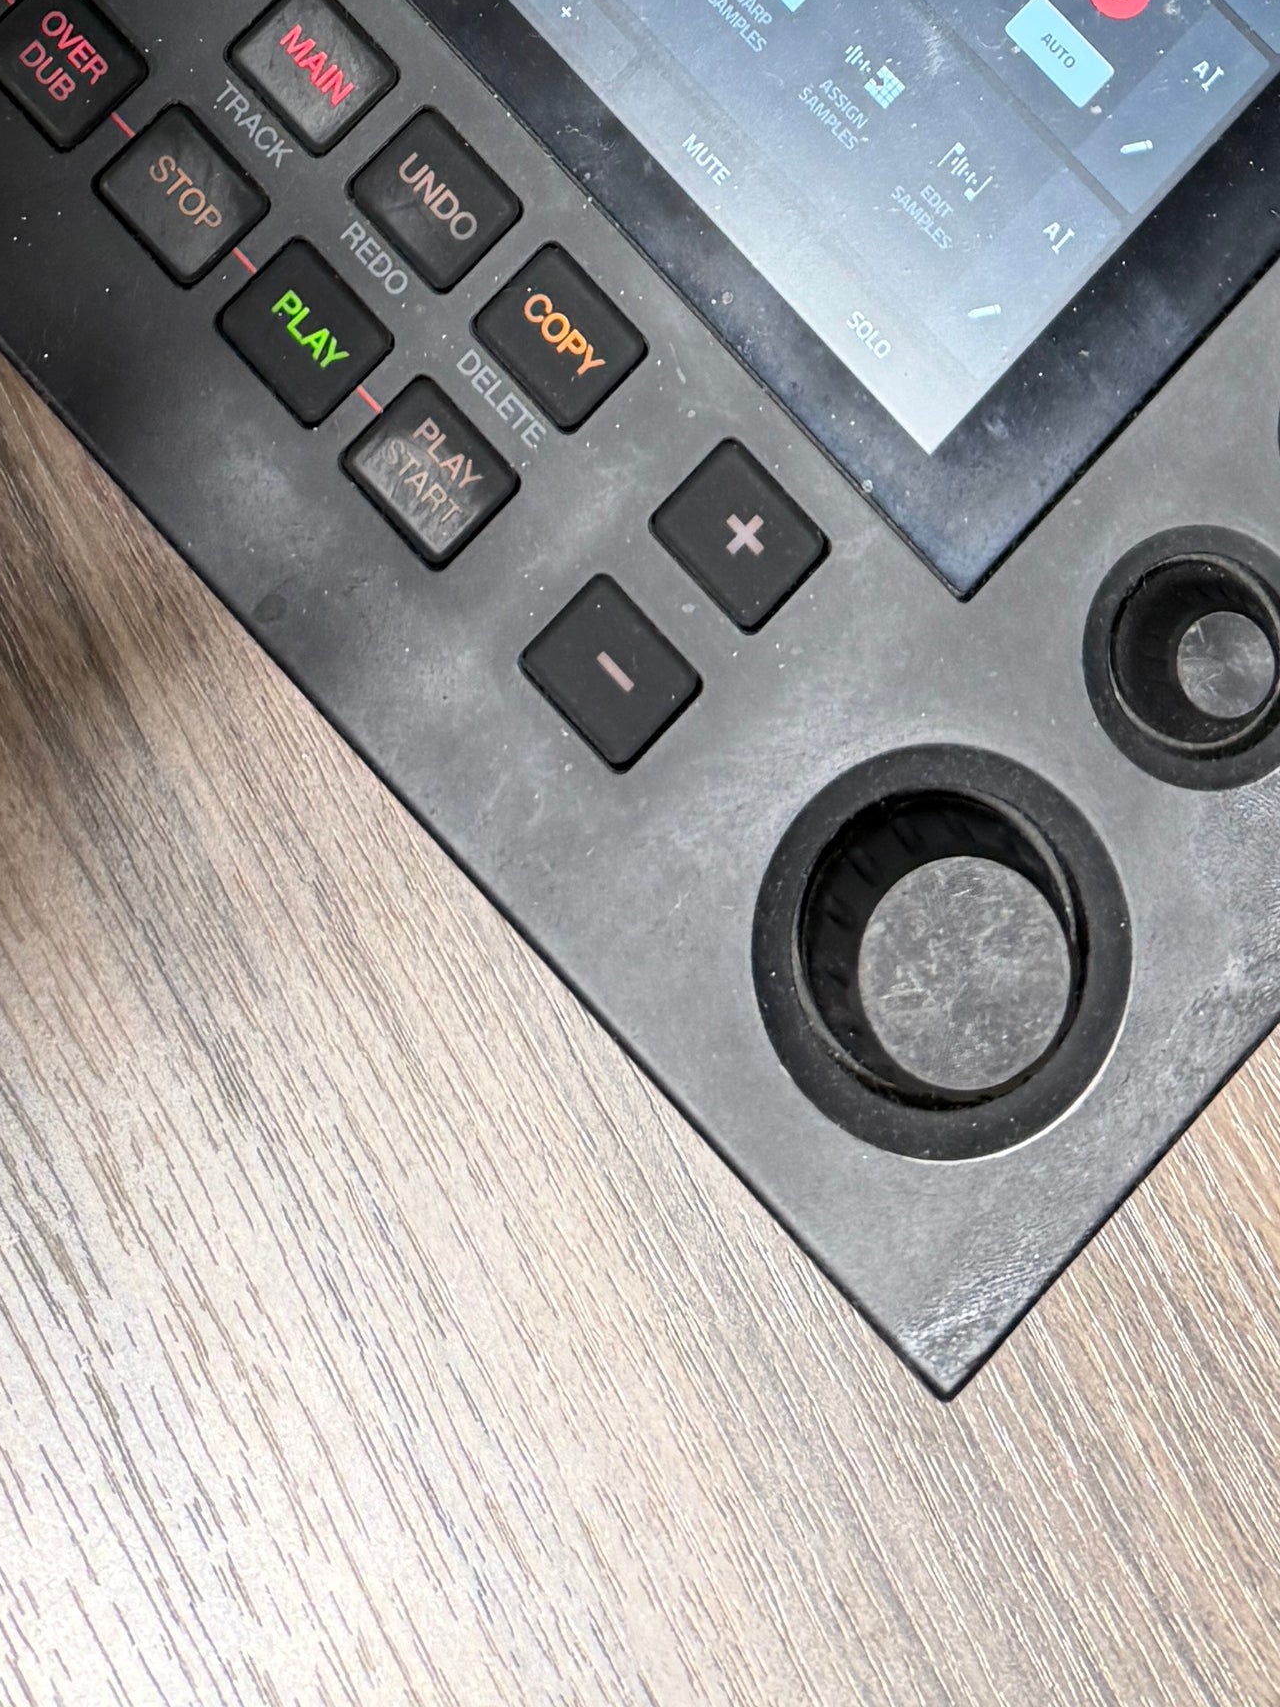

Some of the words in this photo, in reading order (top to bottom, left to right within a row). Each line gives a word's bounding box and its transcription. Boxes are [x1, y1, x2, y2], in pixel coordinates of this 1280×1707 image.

[18, 39, 77, 104] DUB
[40, 9, 110, 85] OVER
[279, 24, 357, 108] MAIN
[1040, 32, 1077, 70] AUTO
[214, 80, 294, 170] TRACK
[682, 132, 732, 186] MUTE
[148, 153, 224, 231] STOP
[398, 151, 480, 243] UNDO
[338, 219, 411, 299] REDO
[271, 288, 350, 371] PLAY
[522, 291, 607, 379] COPY
[846, 310, 893, 360] SOLO
[454, 348, 548, 451] DELETE
[380, 435, 466, 526] START
[413, 416, 485, 491] PLAY
